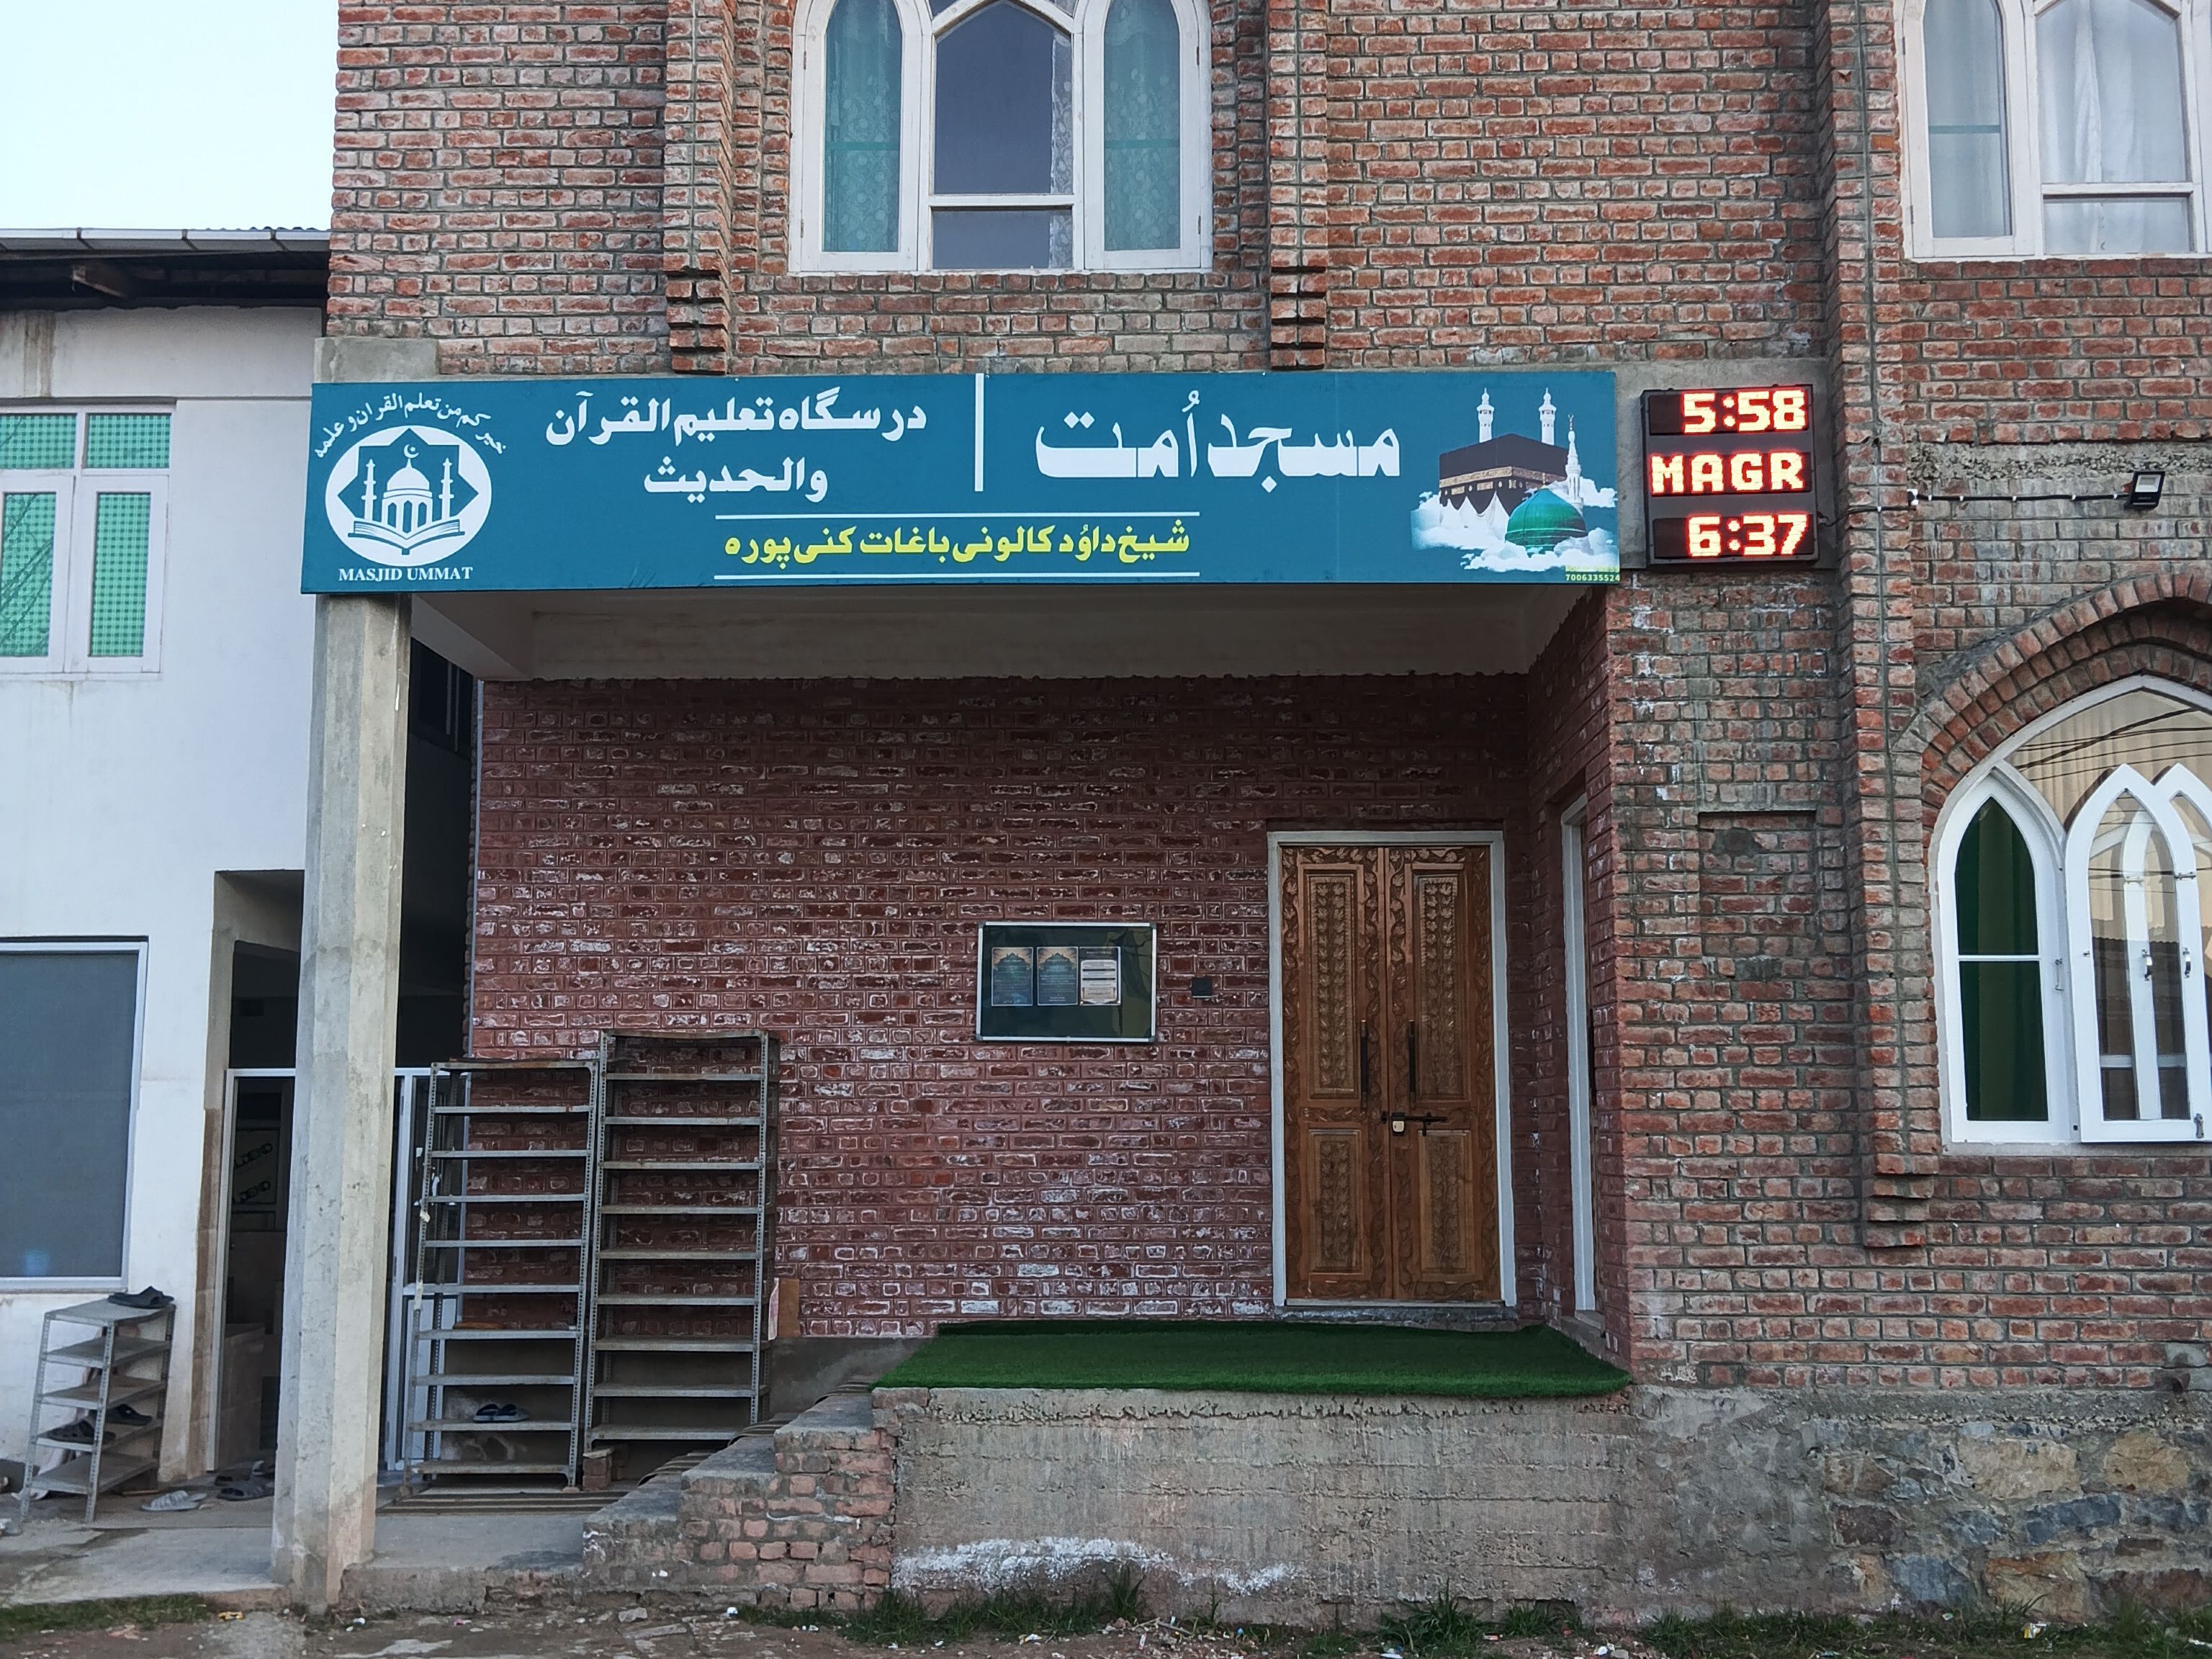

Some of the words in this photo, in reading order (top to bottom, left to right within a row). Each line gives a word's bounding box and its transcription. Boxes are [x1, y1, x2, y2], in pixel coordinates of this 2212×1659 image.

[546, 391, 670, 446] القرآن
[673, 397, 775, 446] تعلیم
[778, 386, 927, 441] درسگاہ
[1684, 390, 1806, 433] 5:58
[1208, 413, 1401, 493] مسجد
[1652, 451, 1803, 494] MAGR
[644, 456, 828, 503] والحدیث
[860, 526, 950, 563] باغات
[952, 525, 1056, 562] کالونی
[1118, 519, 1190, 563] شیخ
[1688, 514, 1807, 557] 6:37
[339, 568, 403, 581] MASJID
[407, 567, 473, 580] UMMAT
